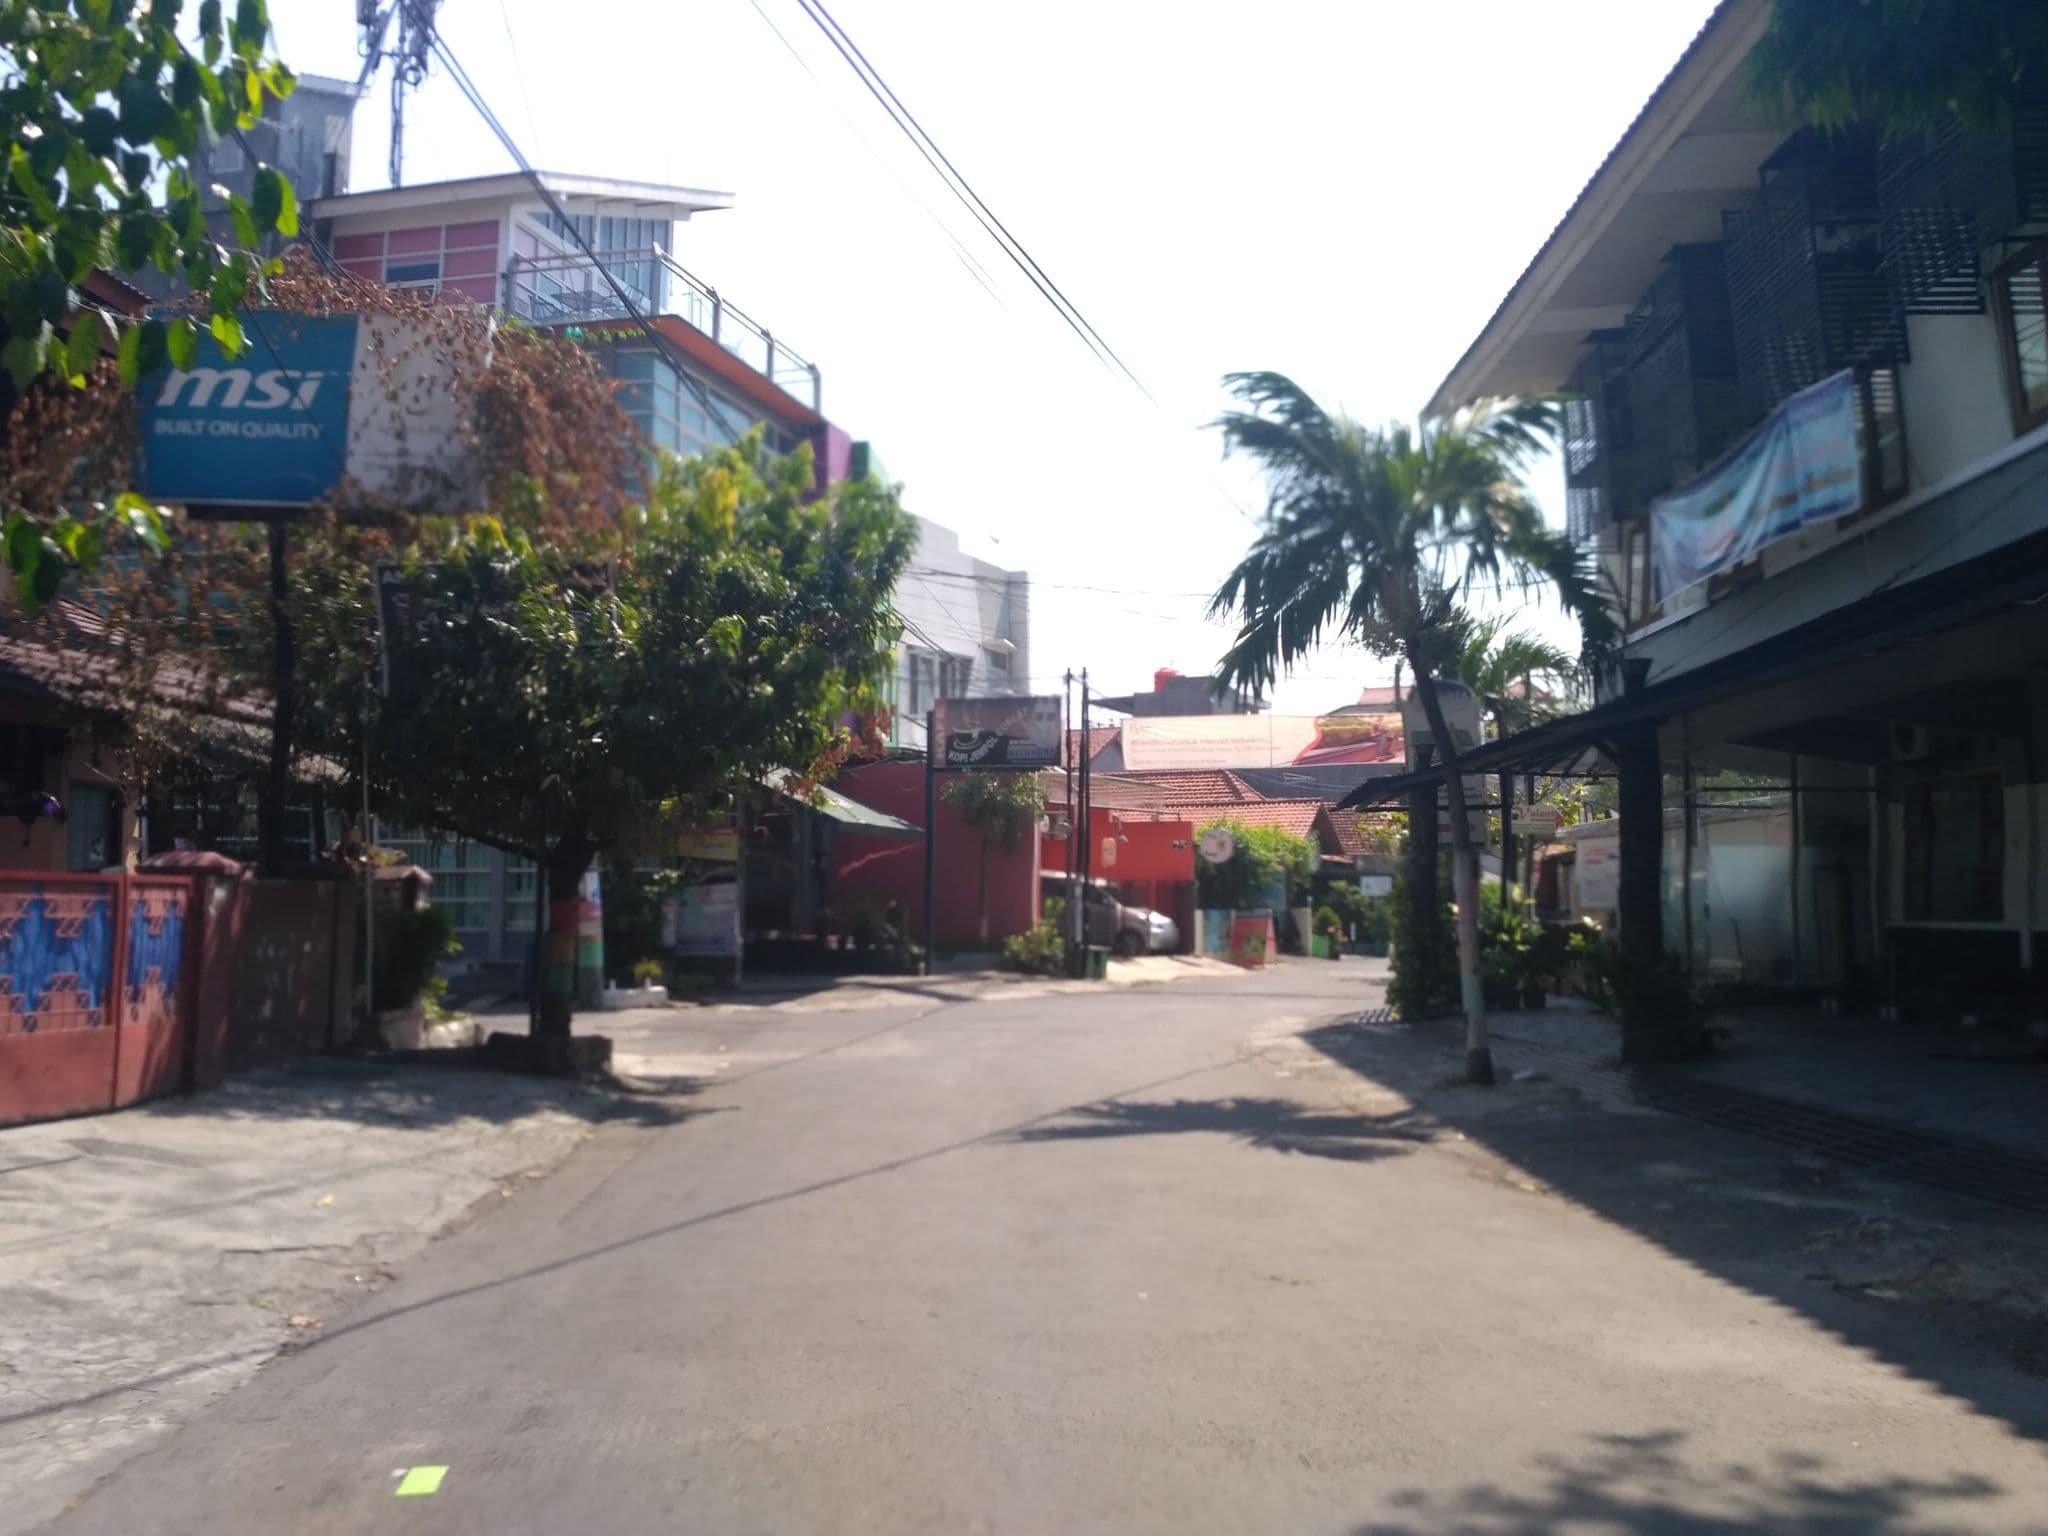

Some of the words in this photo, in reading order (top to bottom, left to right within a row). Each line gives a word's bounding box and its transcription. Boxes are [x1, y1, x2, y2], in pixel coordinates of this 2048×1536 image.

[156, 367, 323, 409] msi
[155, 420, 205, 436] BUILT
[208, 420, 240, 437] ON
[241, 422, 322, 439] QUALITY
[948, 749, 968, 762] KOPI
